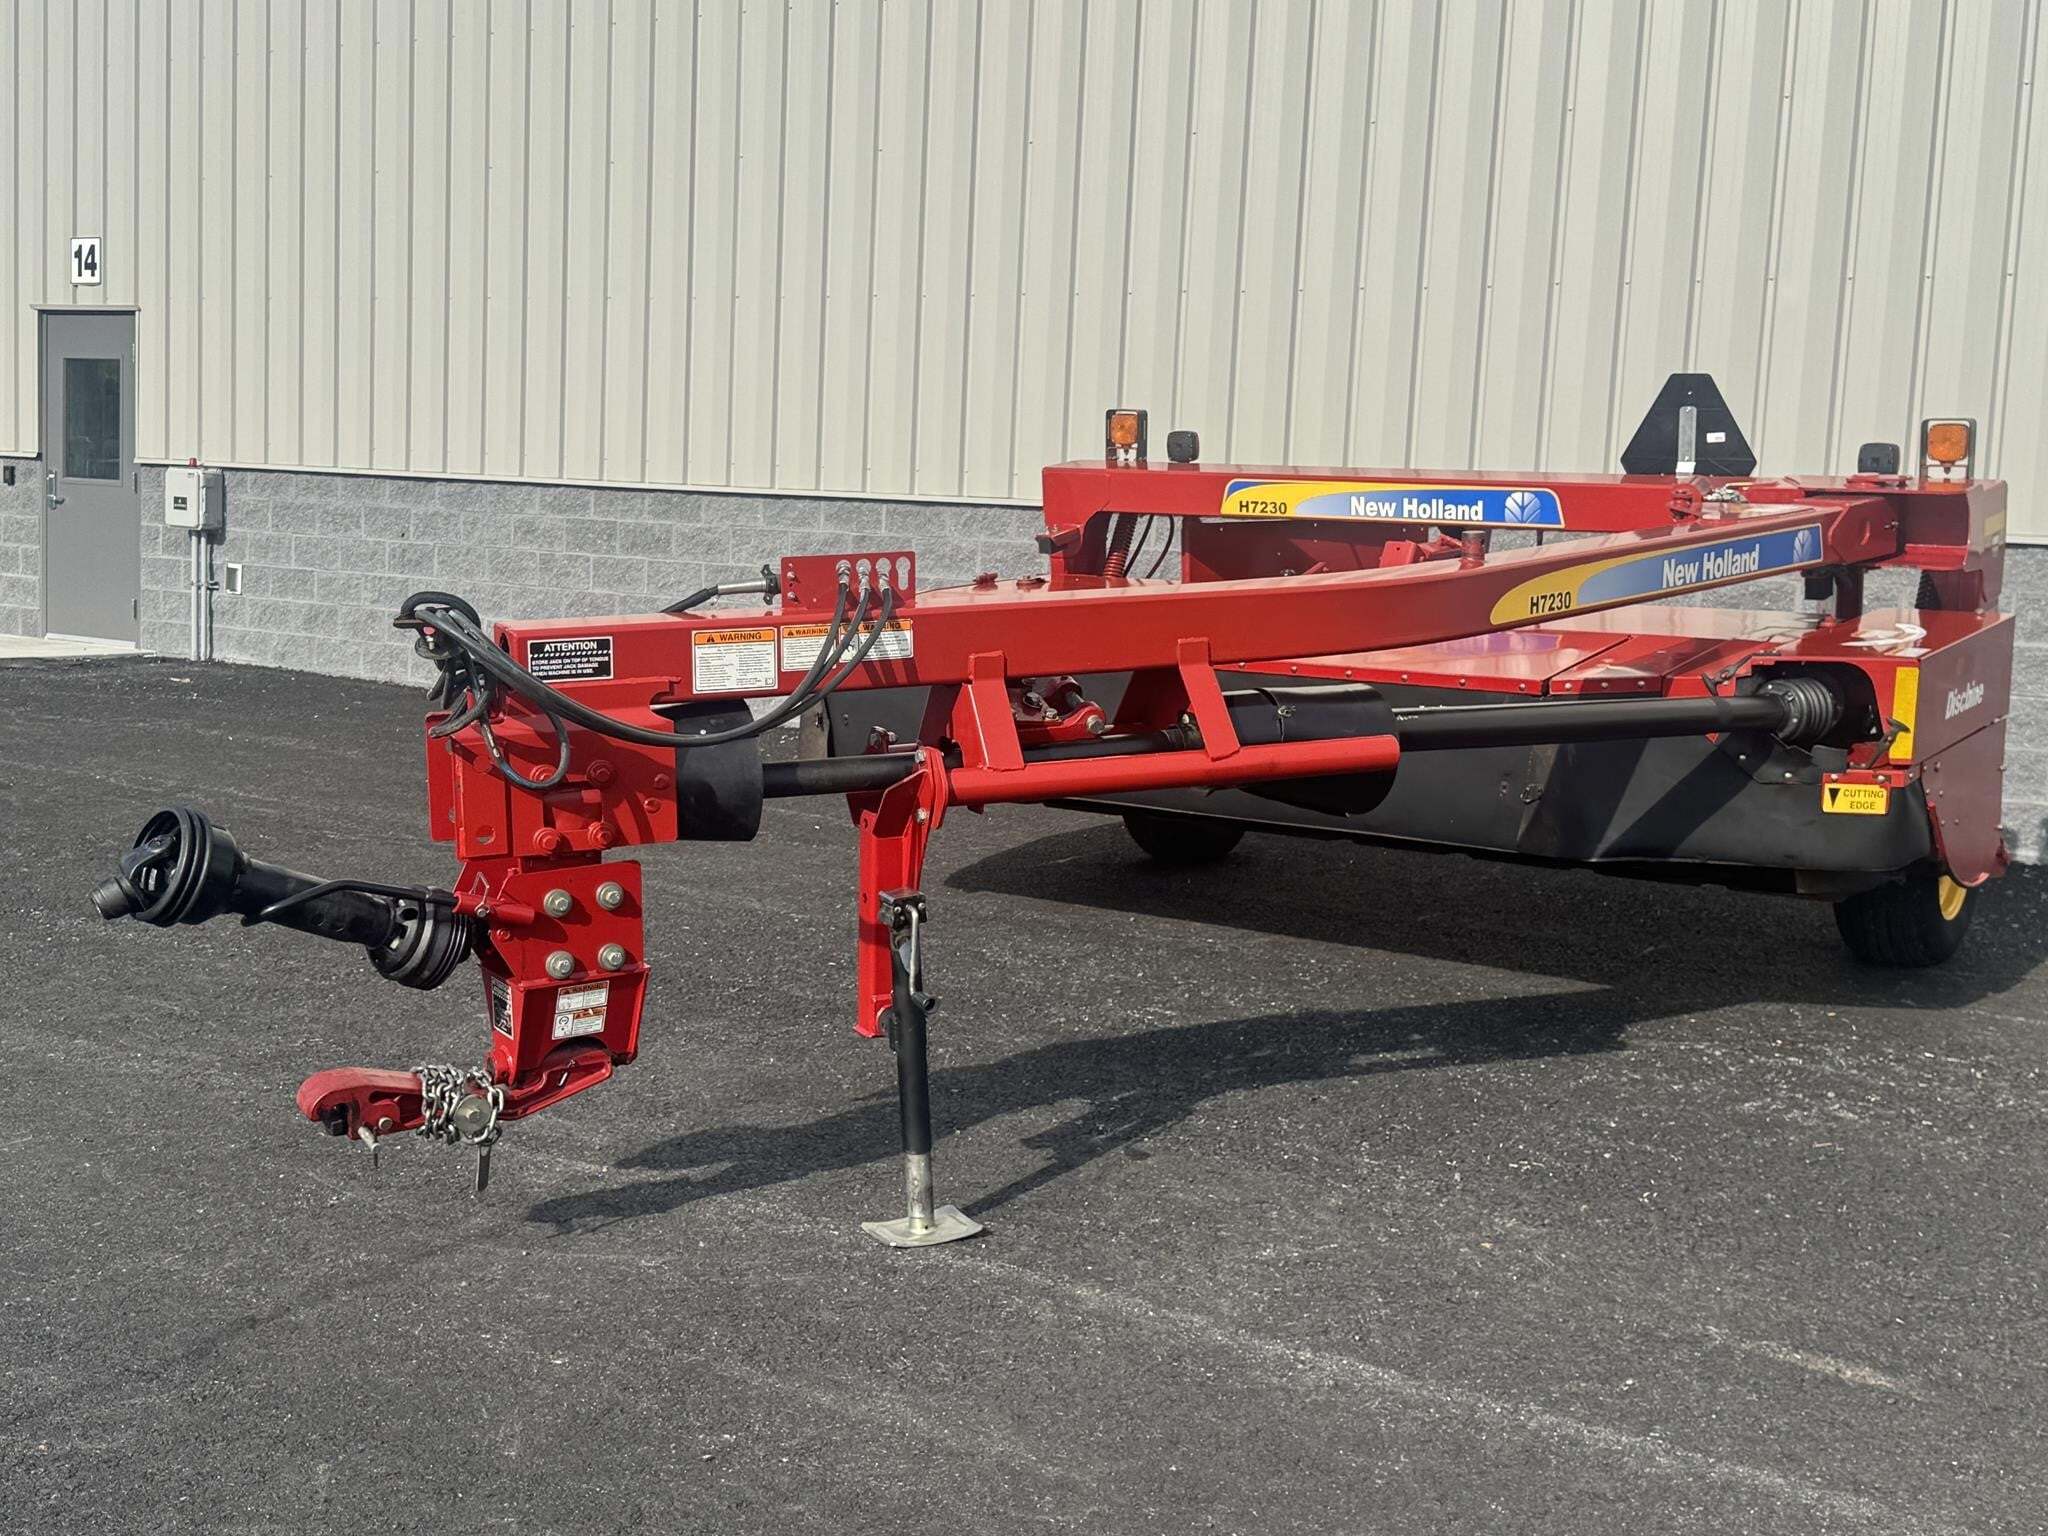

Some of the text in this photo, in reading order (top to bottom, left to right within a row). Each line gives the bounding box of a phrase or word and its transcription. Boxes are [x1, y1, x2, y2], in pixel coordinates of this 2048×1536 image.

[74, 244, 97, 277] 14
[1239, 495, 1484, 521] H7230 New Holland
[1662, 543, 1760, 588] New Holland
[1529, 590, 1572, 615] H7230
[719, 632, 762, 641] WARNING
[795, 628, 829, 636] WARNING
[543, 641, 598, 652] ATTENTION
[1944, 679, 1985, 721] Discbine
[1842, 788, 1885, 799] CUTTING
[1849, 800, 1877, 810] EDGE
